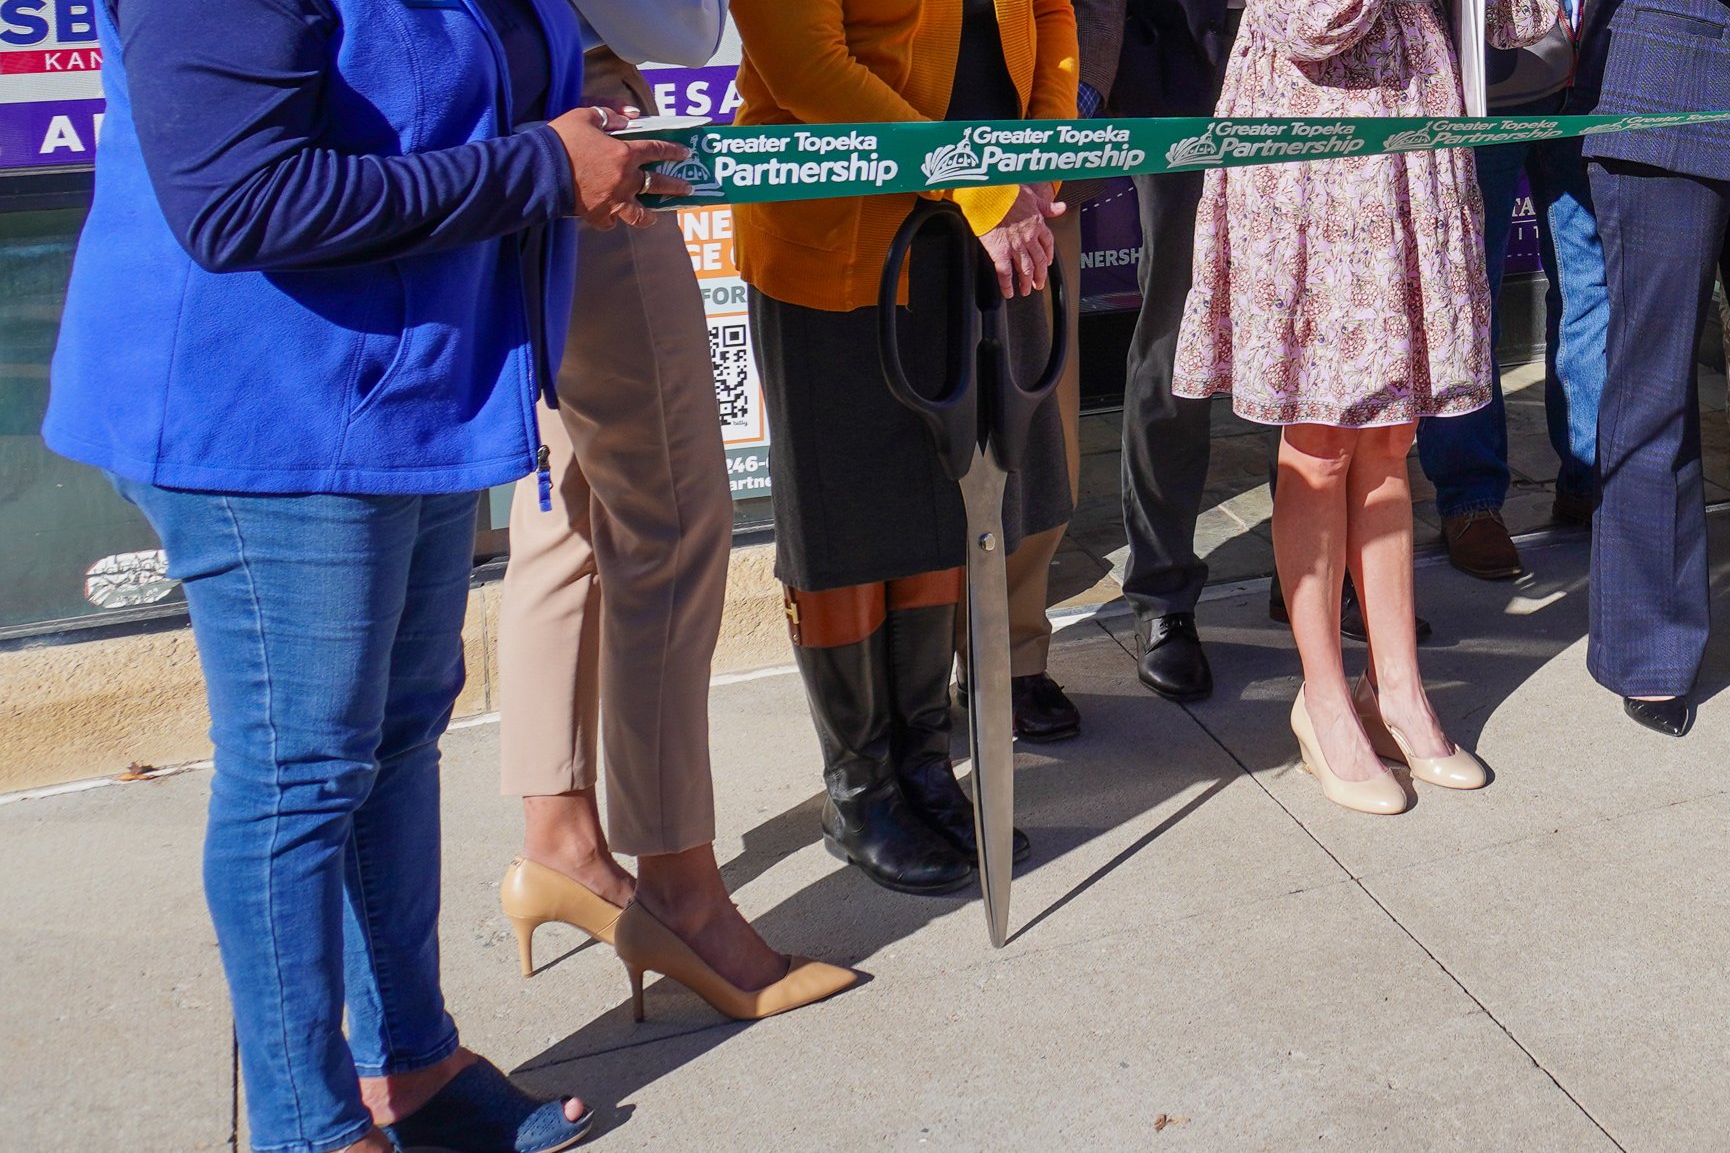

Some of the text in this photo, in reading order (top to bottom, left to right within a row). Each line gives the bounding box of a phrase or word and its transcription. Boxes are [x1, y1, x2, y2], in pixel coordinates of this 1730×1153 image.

[973, 125, 1130, 146] Greater Topeka
[1215, 122, 1356, 137] Greater Topeka
[1432, 119, 1558, 132] Greater Topeka
[701, 131, 877, 154] Greater Topeka
[1220, 135, 1365, 158] Partnership
[1432, 129, 1563, 145] Partnership
[983, 144, 1145, 171] Partnership
[714, 152, 898, 187] Partnership
